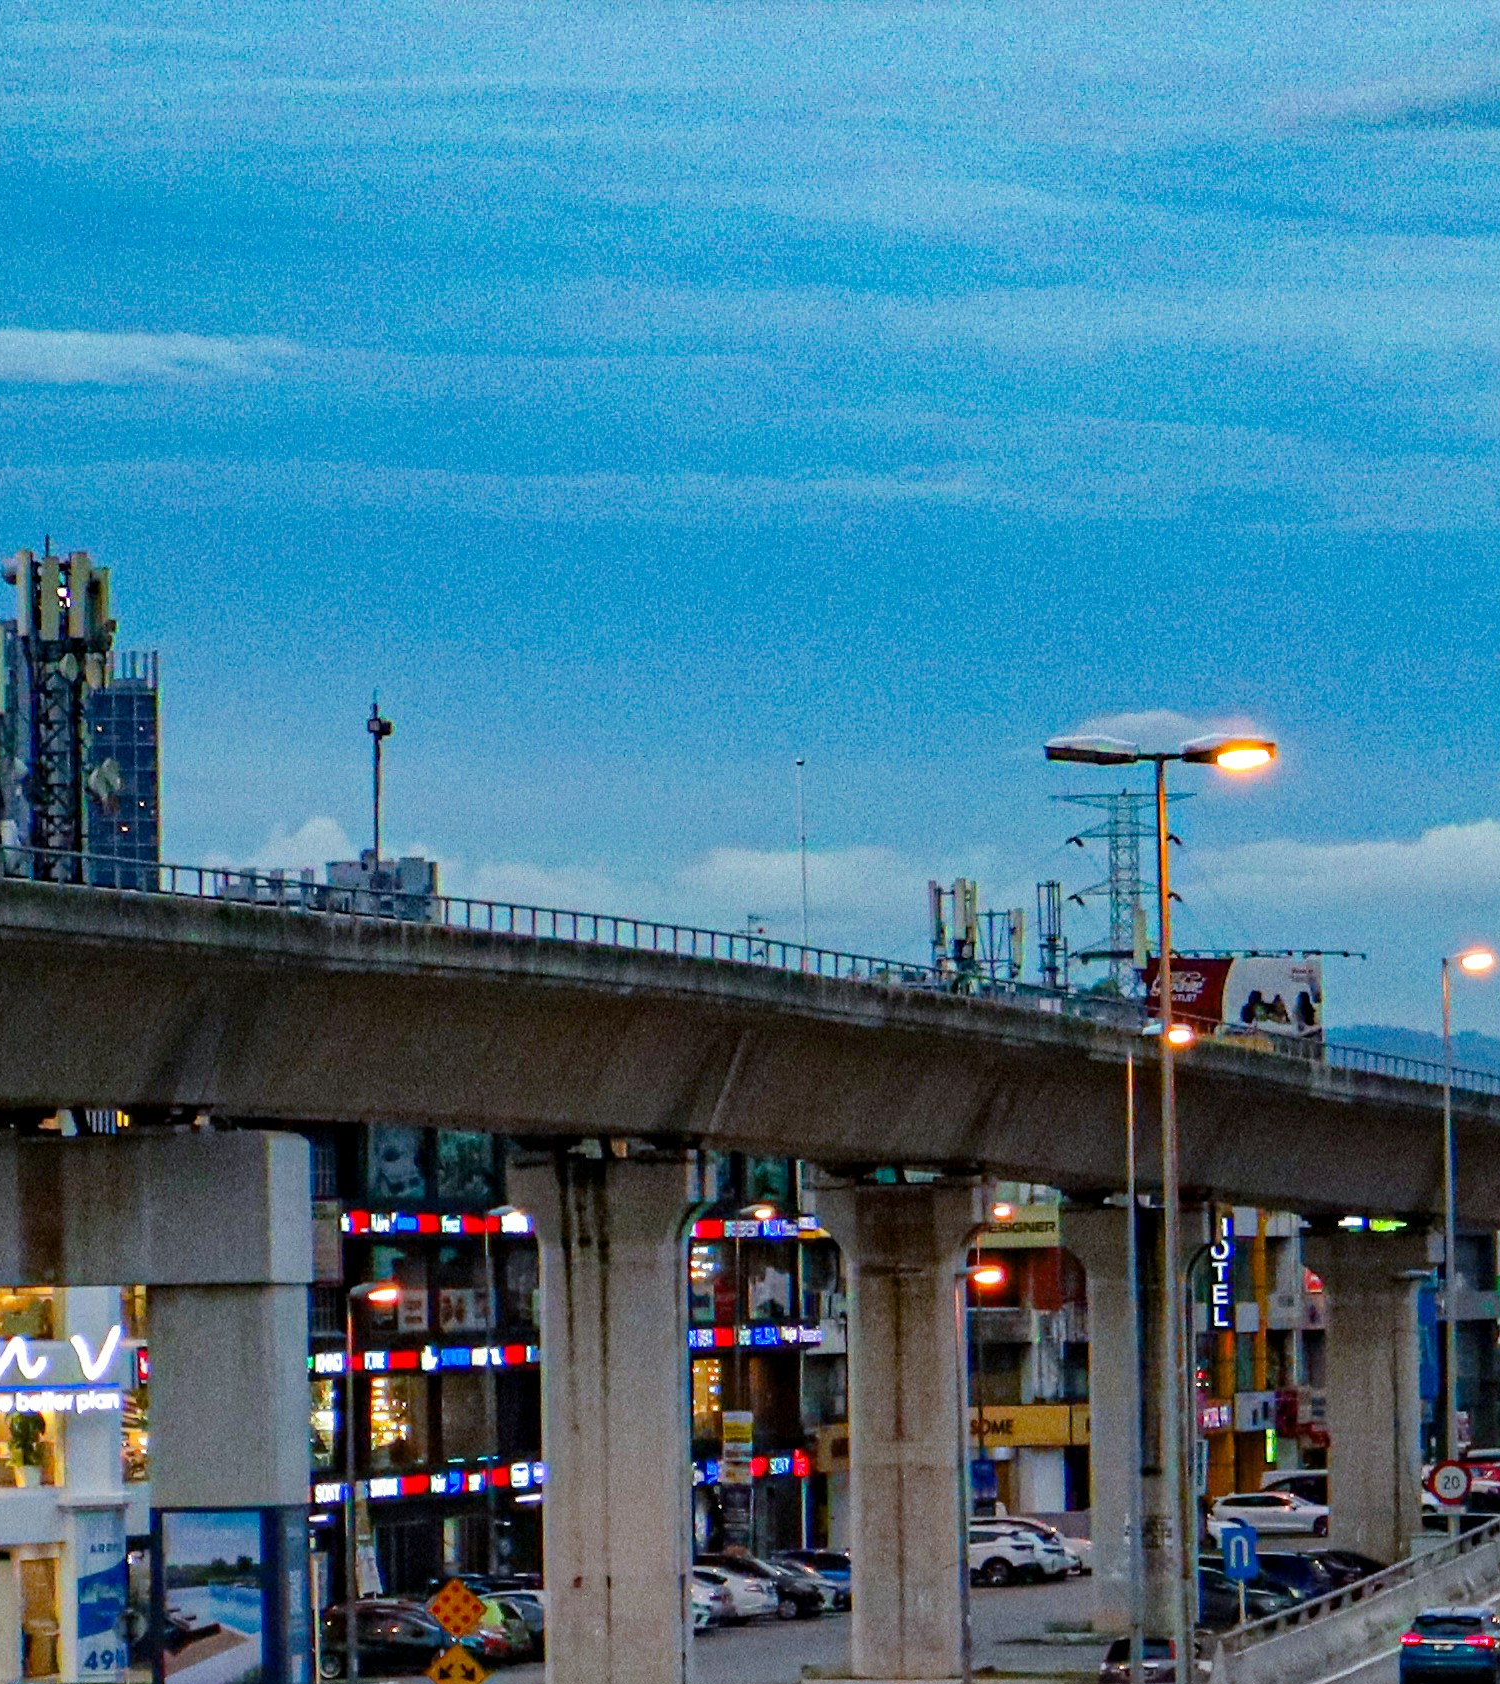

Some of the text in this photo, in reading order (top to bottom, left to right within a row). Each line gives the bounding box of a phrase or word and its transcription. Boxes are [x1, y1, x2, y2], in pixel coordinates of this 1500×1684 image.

[16, 1391, 73, 1413] better
[76, 1390, 120, 1415] plan
[1442, 1475, 1461, 1490] 20
